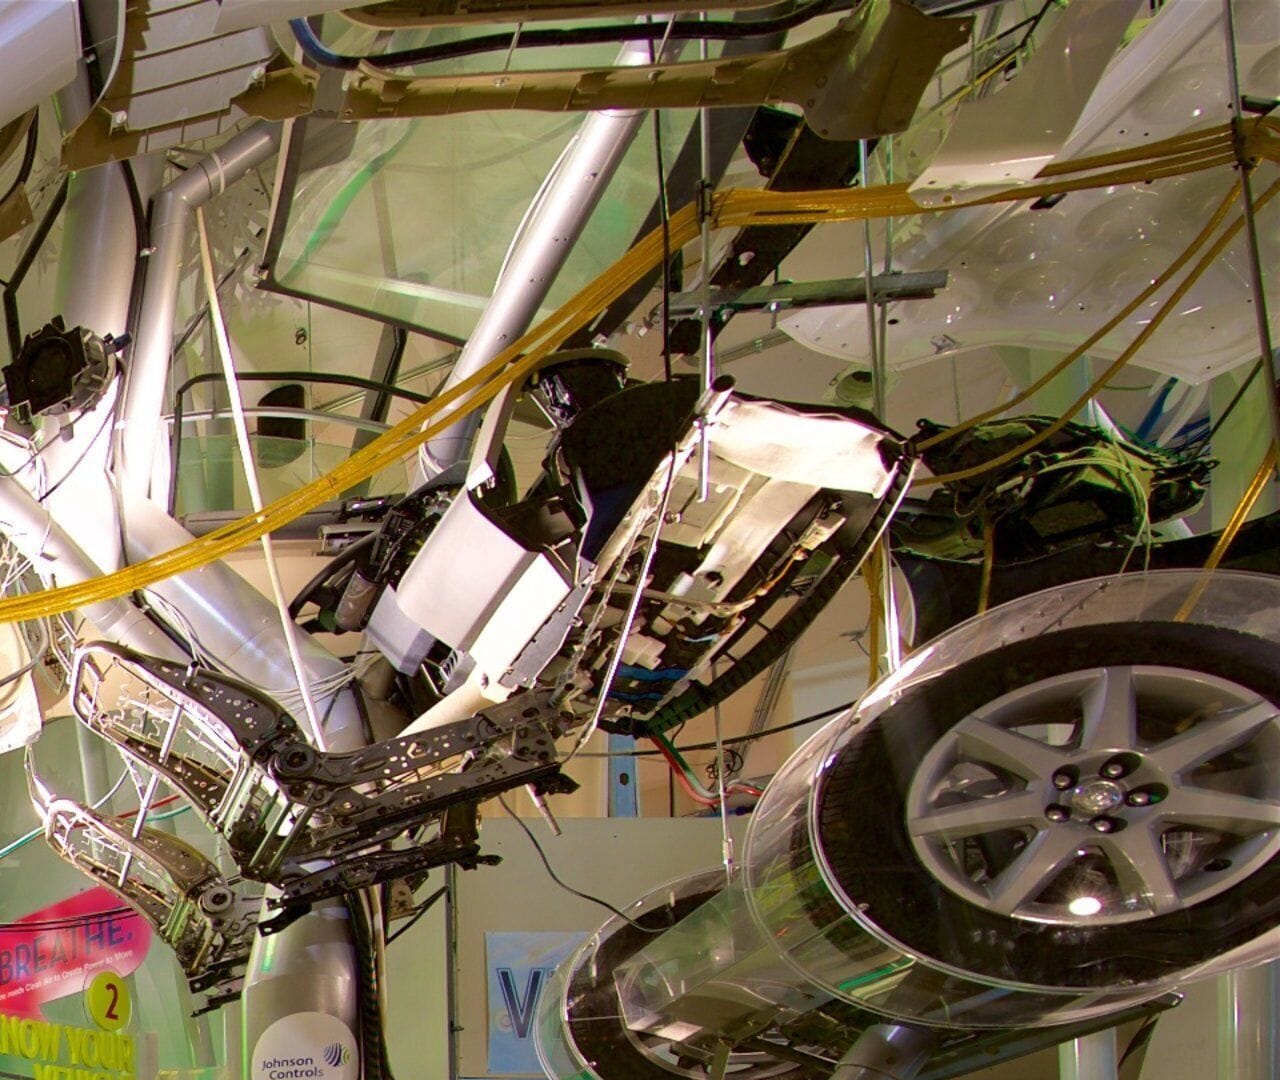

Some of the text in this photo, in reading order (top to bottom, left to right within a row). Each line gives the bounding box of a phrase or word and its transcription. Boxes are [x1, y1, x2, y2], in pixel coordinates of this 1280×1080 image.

[104, 983, 119, 1020] 2
[65, 1024, 135, 1073] YOUR
[262, 1057, 313, 1071] Johnson
[269, 1067, 324, 1080] Controls
